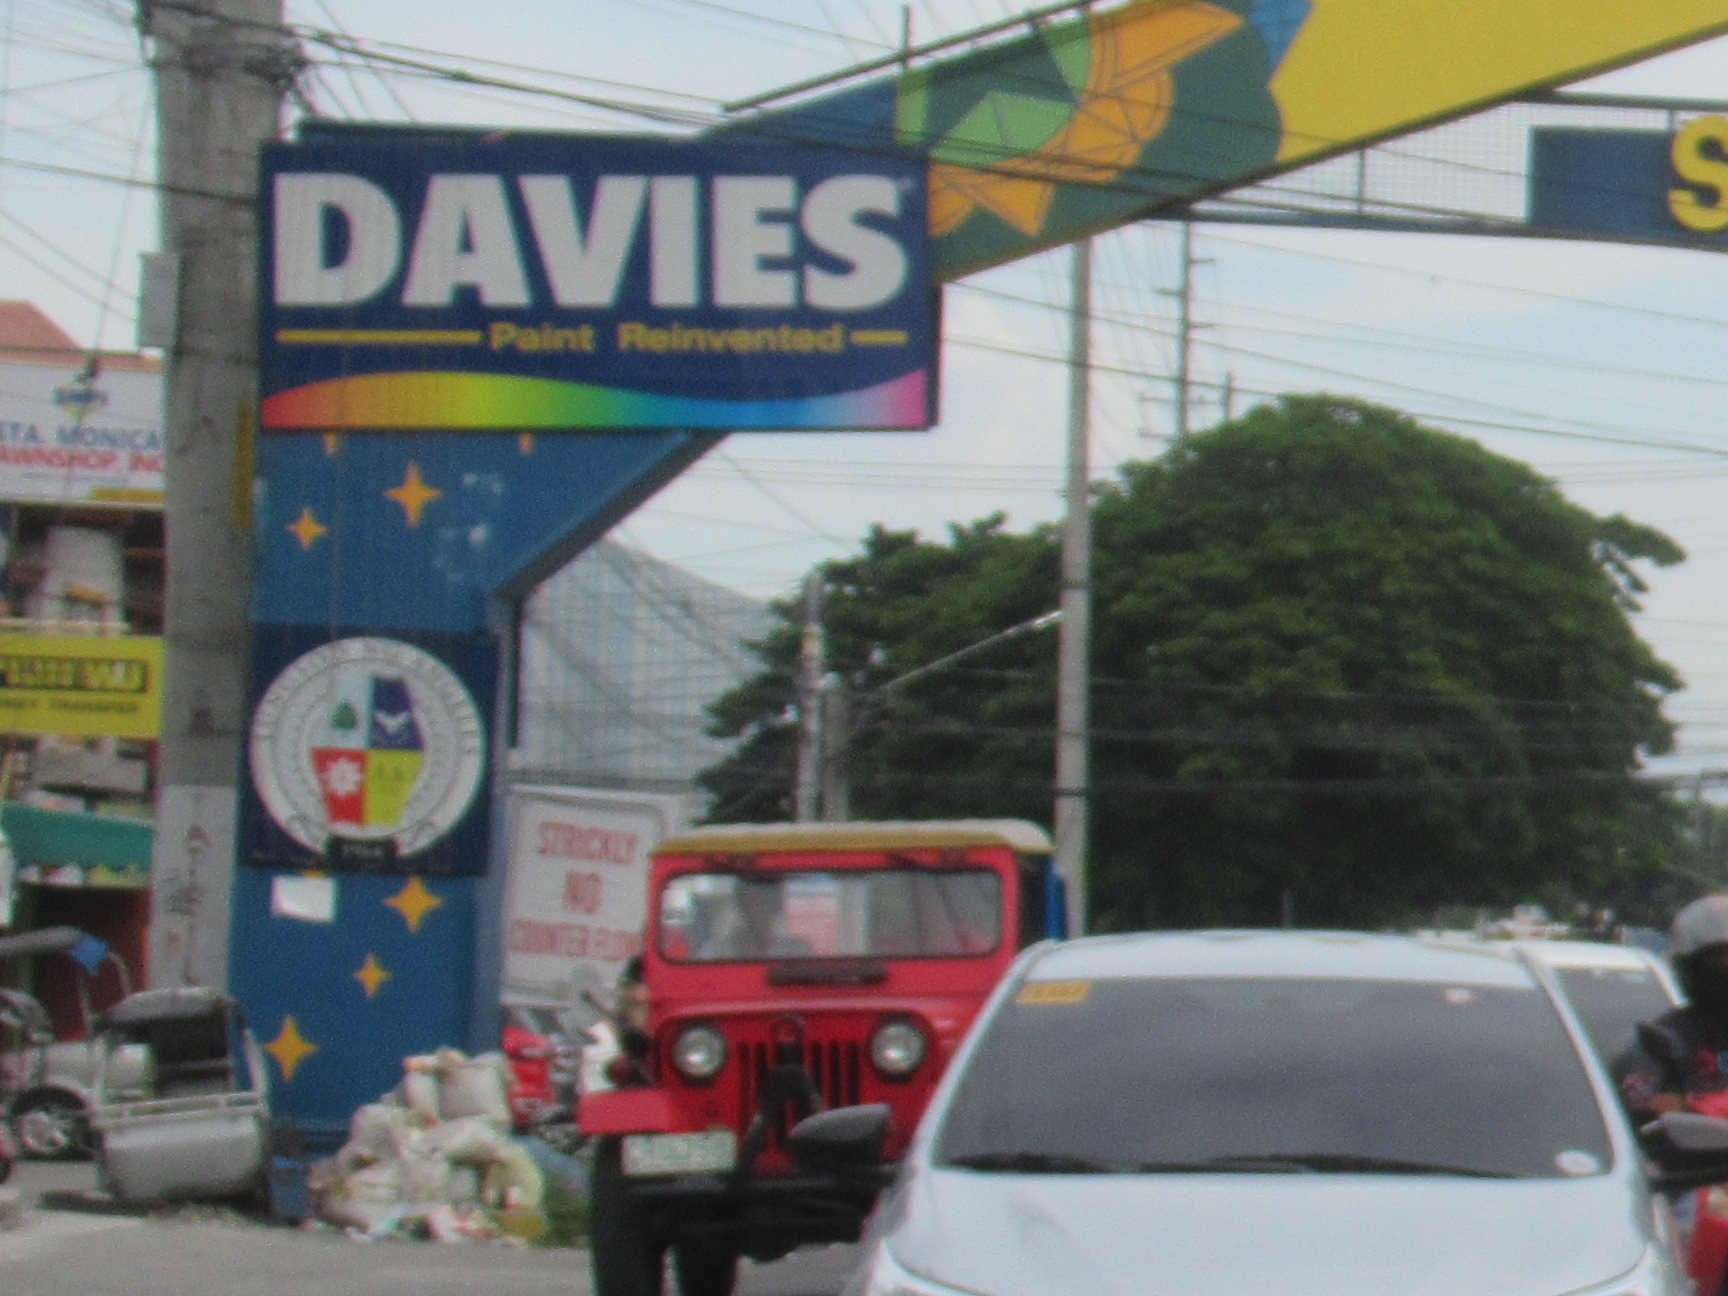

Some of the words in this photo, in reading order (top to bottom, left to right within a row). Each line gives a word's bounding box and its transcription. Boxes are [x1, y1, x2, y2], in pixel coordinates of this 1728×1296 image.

[274, 172, 910, 310] DAVIES
[489, 321, 596, 354] Paint
[618, 321, 846, 355] Reinvented
